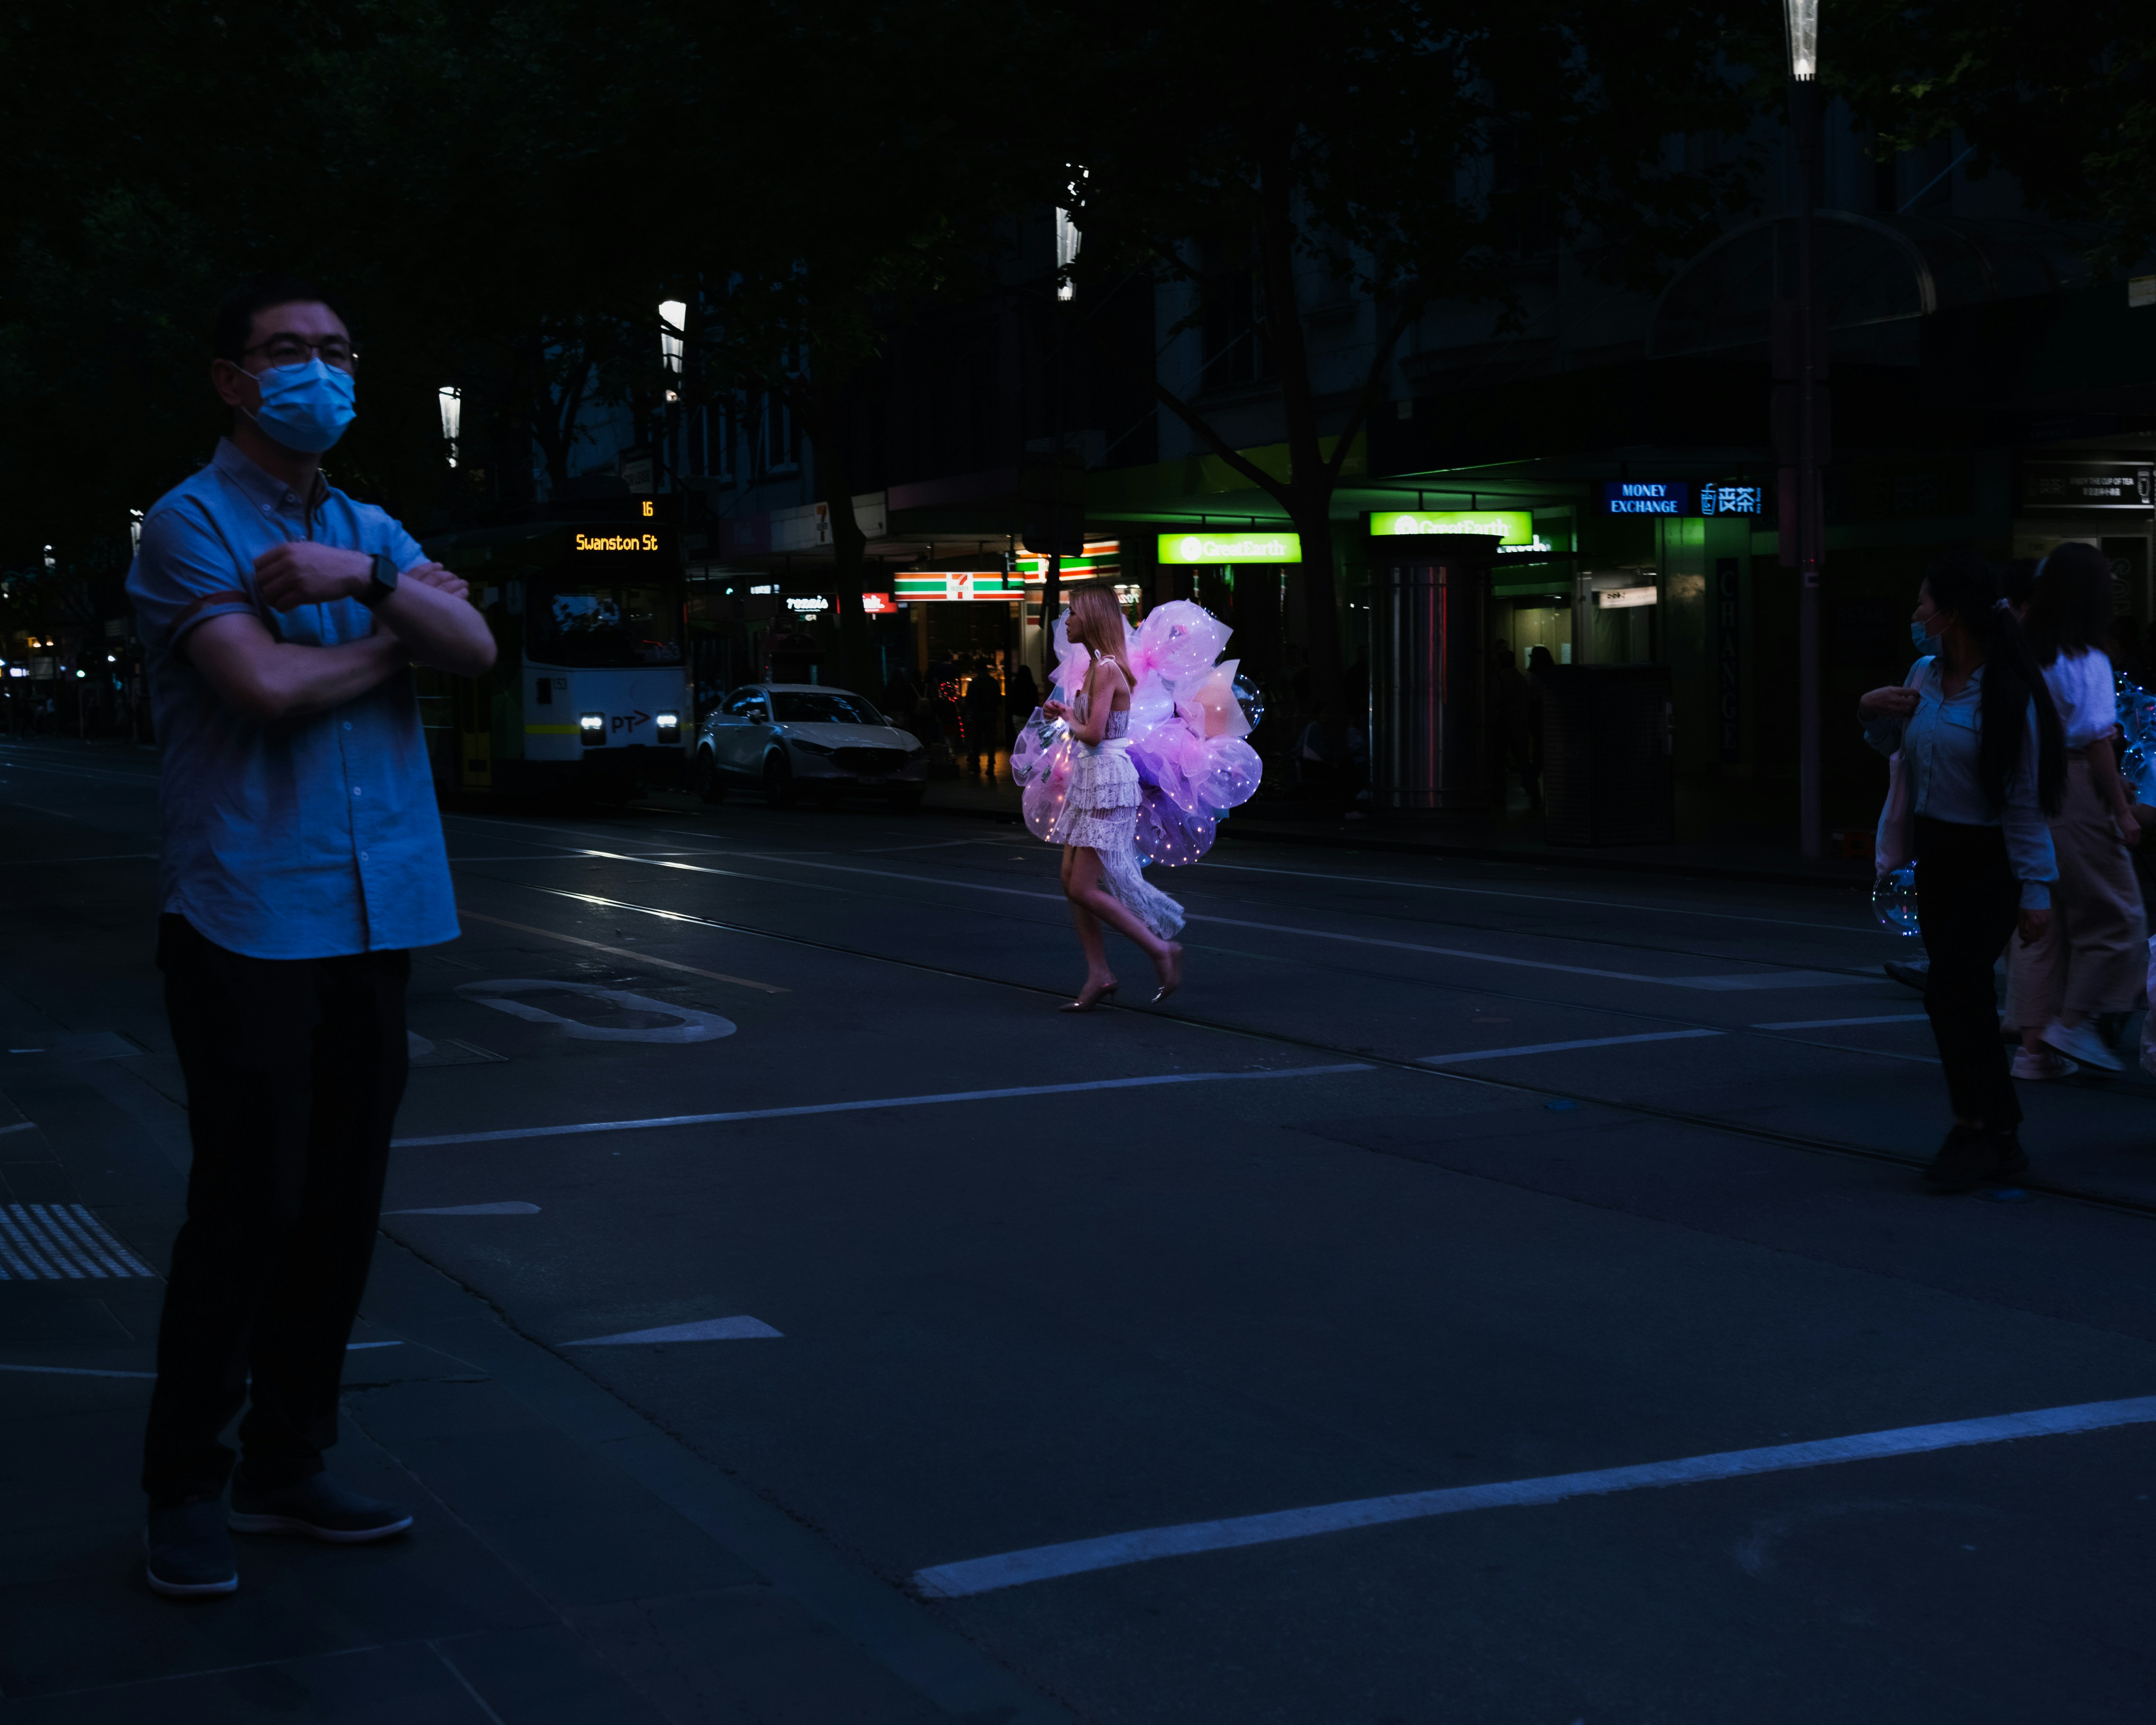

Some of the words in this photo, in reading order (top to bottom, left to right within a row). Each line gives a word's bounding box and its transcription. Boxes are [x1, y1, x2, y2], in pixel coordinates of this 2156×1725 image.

[1622, 484, 1667, 497] MONEY
[642, 501, 653, 516] 16
[1611, 500, 1679, 513] EXCHANGE
[576, 534, 640, 551] Swanston
[642, 534, 658, 551] St
[1203, 539, 1285, 556] GreatEarth
[1719, 570, 1737, 750] CHANGE
